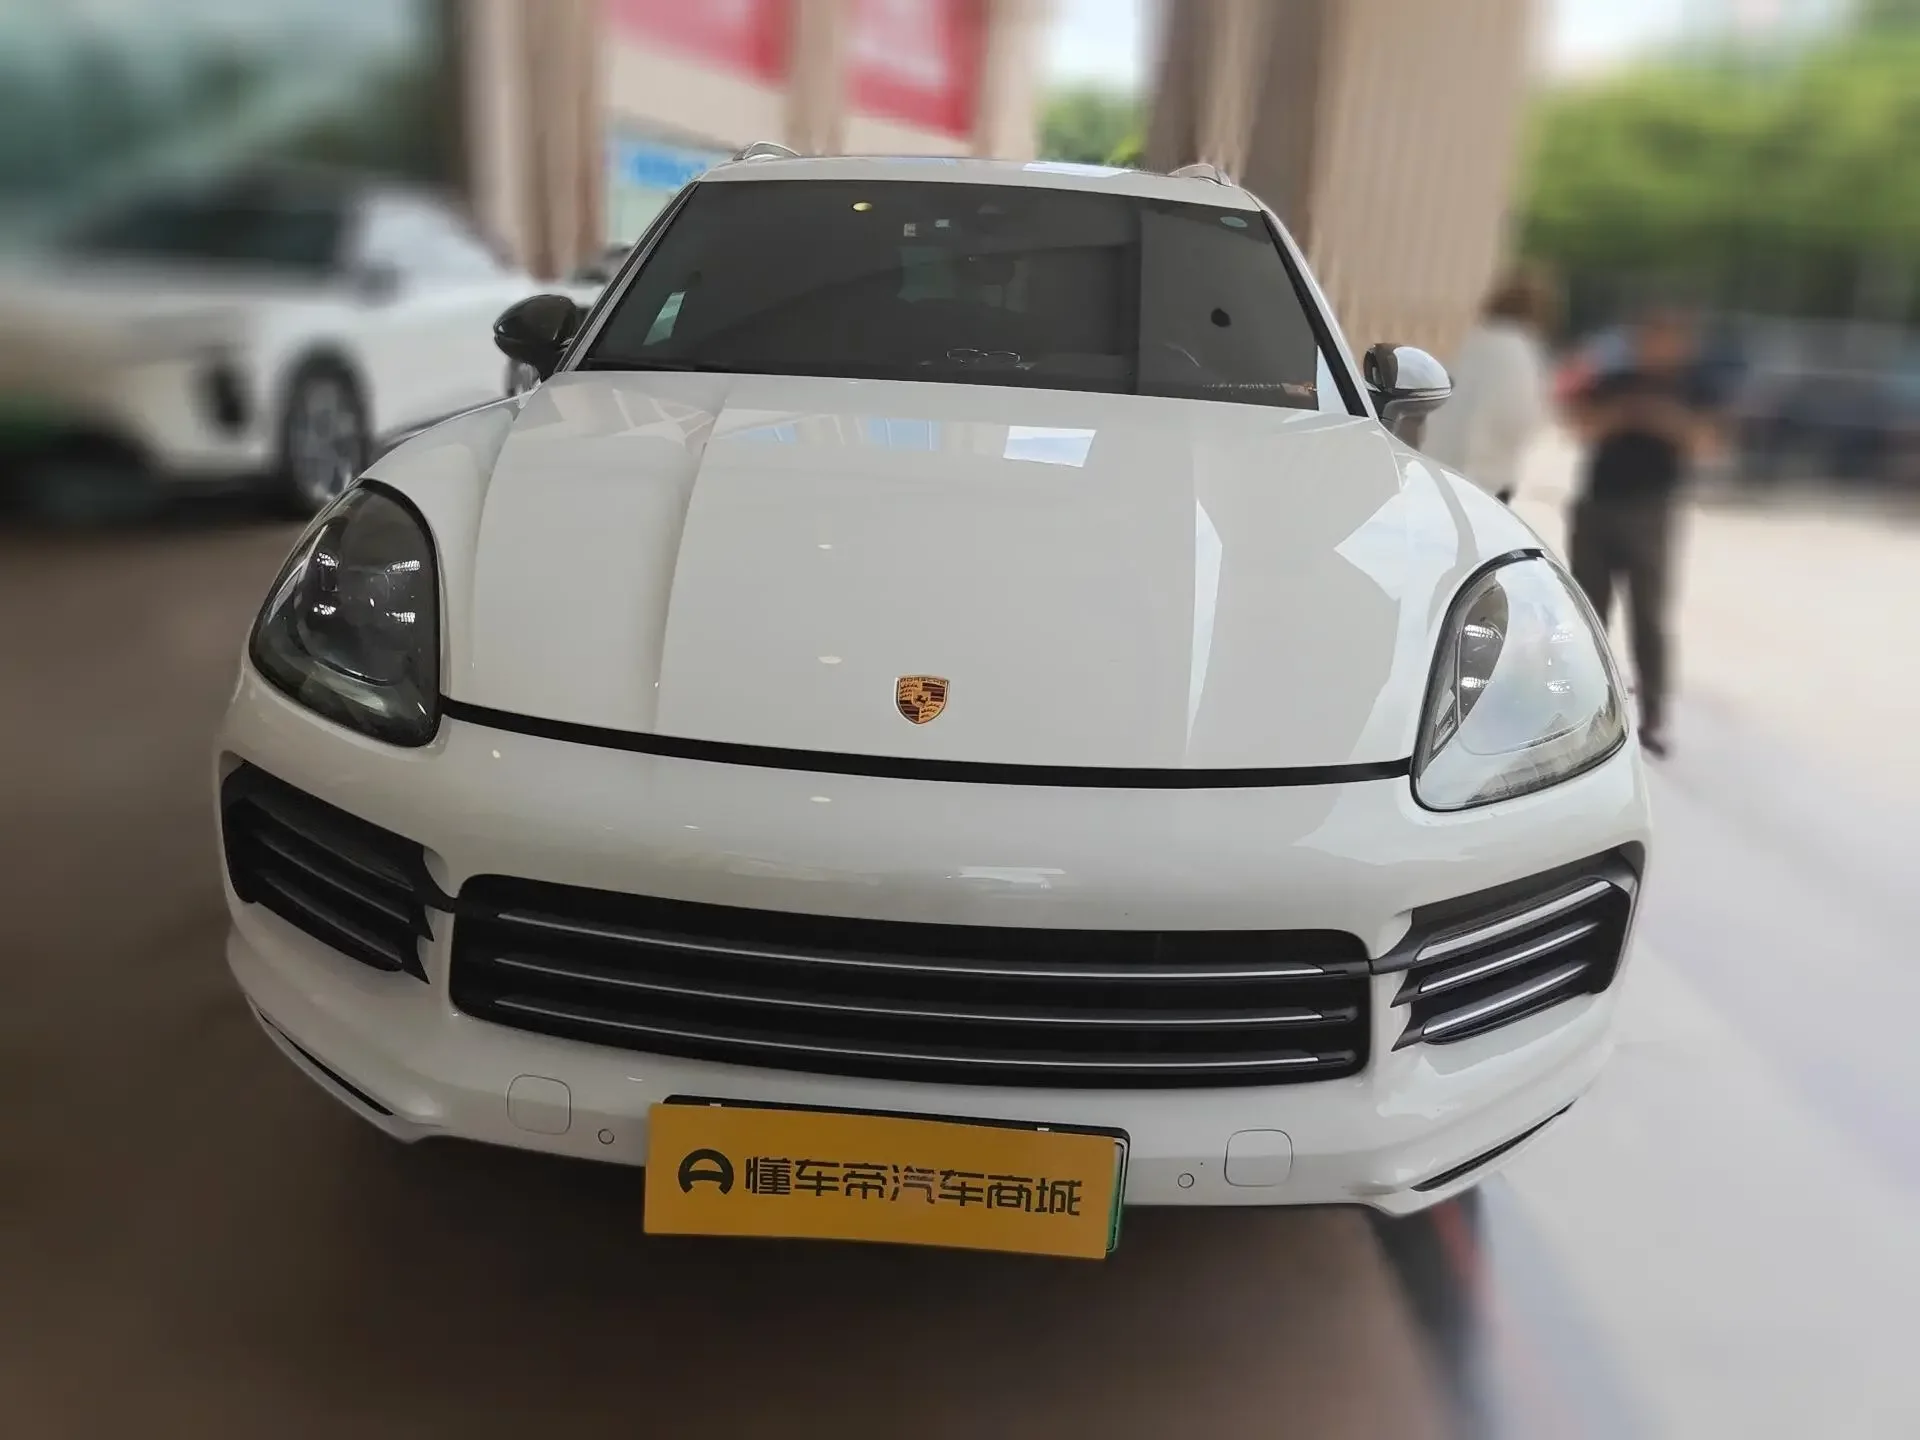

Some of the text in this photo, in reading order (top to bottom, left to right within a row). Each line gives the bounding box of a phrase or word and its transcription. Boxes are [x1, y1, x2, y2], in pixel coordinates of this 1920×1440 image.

[744, 1155, 1082, 1216] 懂车帝汽车商城
